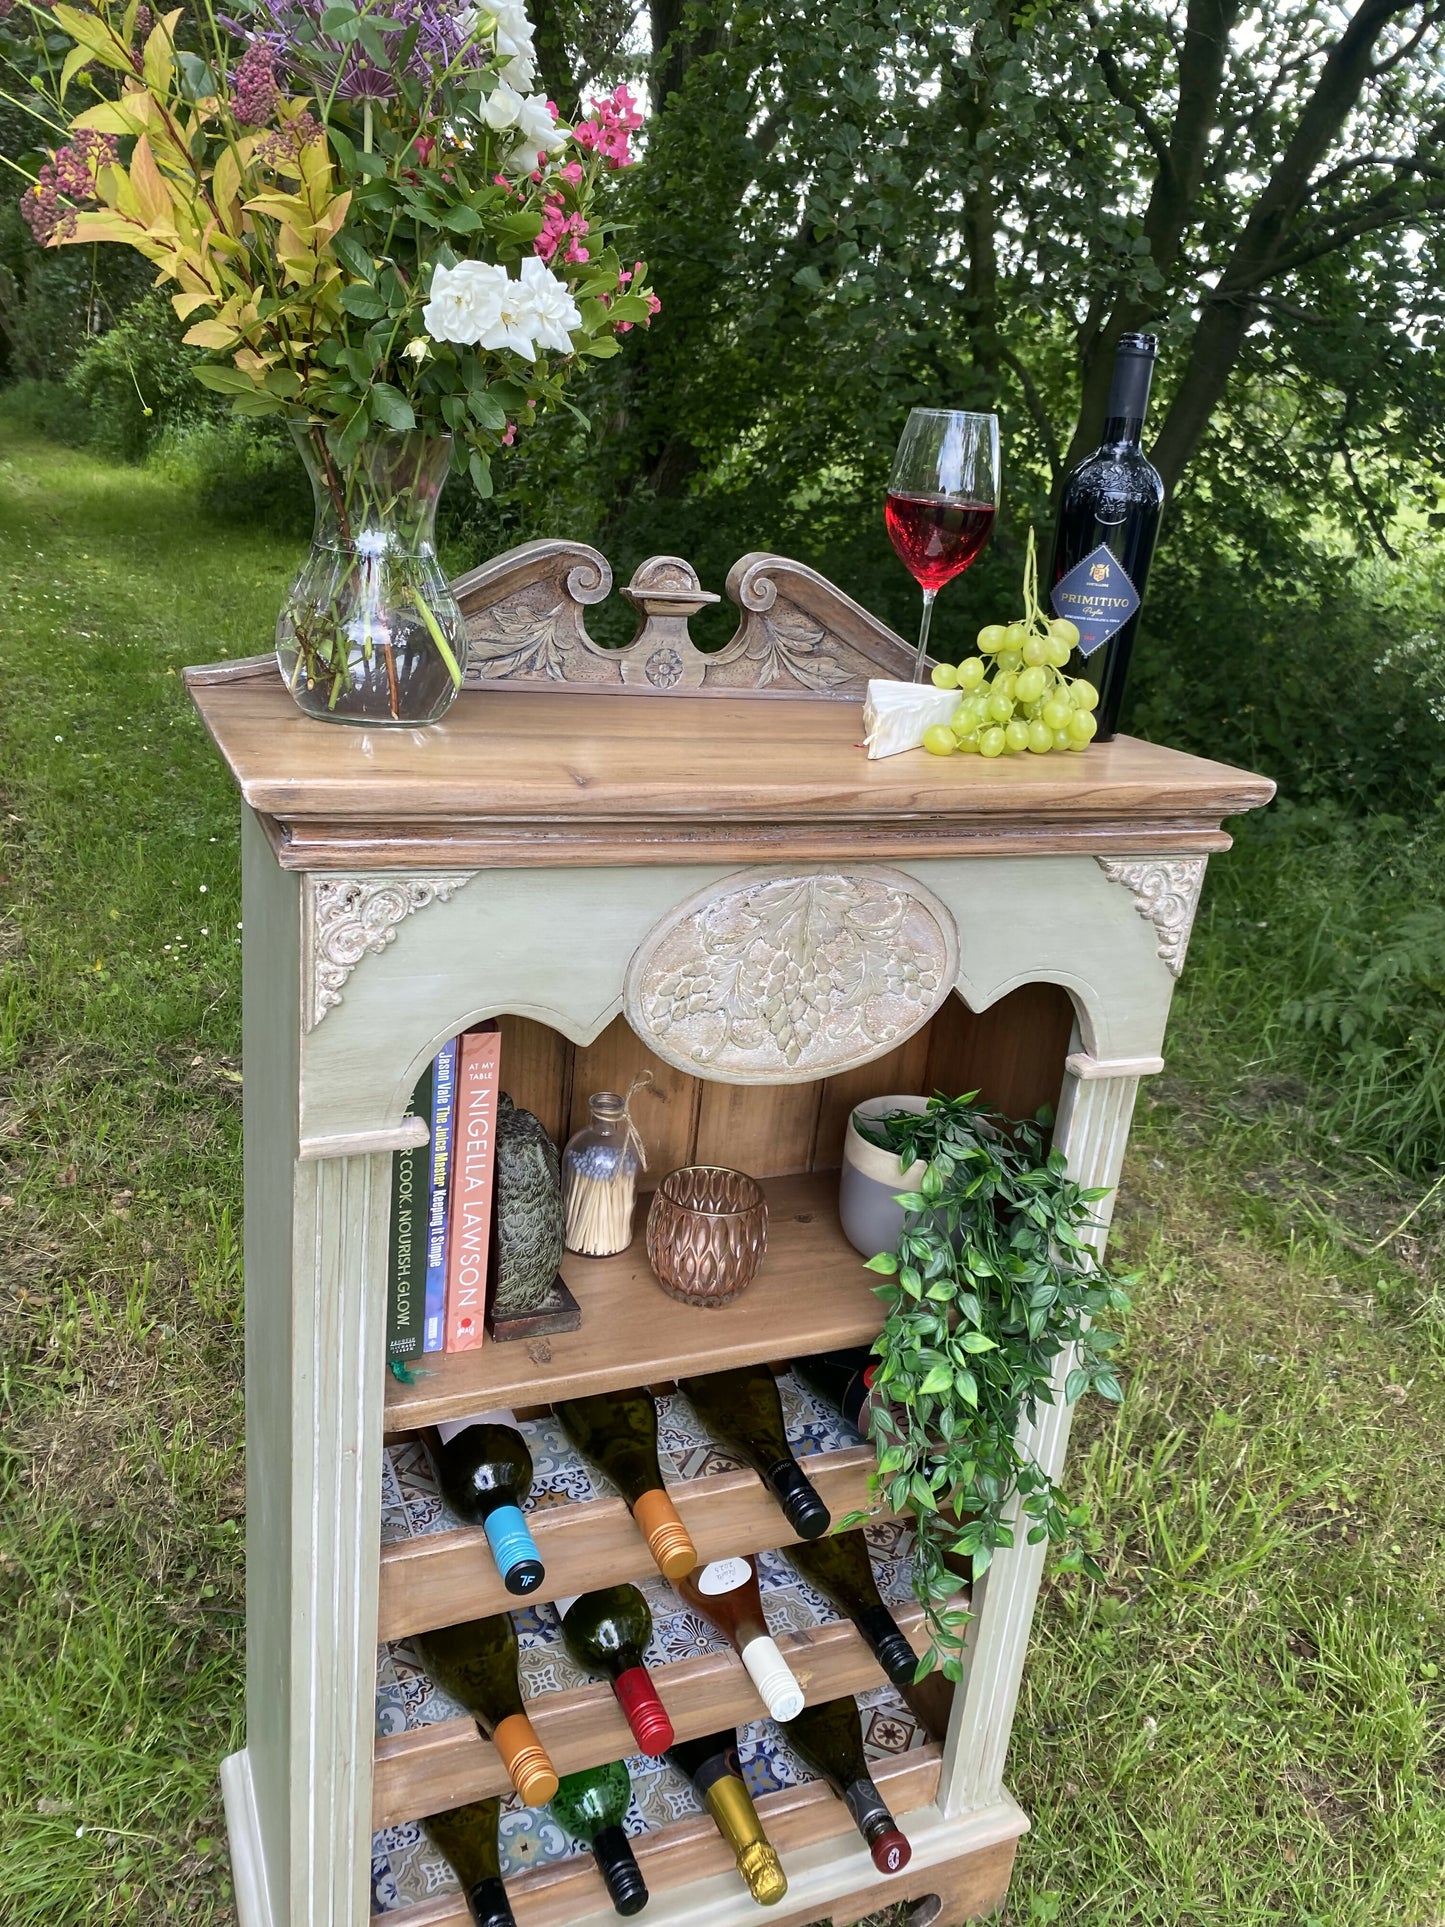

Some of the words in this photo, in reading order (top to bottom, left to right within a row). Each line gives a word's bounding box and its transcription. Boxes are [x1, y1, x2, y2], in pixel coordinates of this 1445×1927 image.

[1061, 592, 1130, 608] PRIMITIVO
[438, 1052, 453, 1081] Jason
[469, 1072, 493, 1080] TABLE
[481, 1062, 494, 1070] MY
[437, 1082, 451, 1104] Vale
[436, 1106, 450, 1124] The
[435, 1126, 449, 1151] Juice
[464, 1089, 491, 1193] NIGELLA
[398, 1160, 413, 1209] COOK.
[433, 1153, 448, 1187] Master
[429, 1189, 447, 1226] Keeping
[397, 1210, 412, 1280] NOURISH.
[428, 1235, 445, 1267] Simple
[458, 1201, 484, 1307] LAWSON
[396, 1281, 411, 1330] GLOW.
